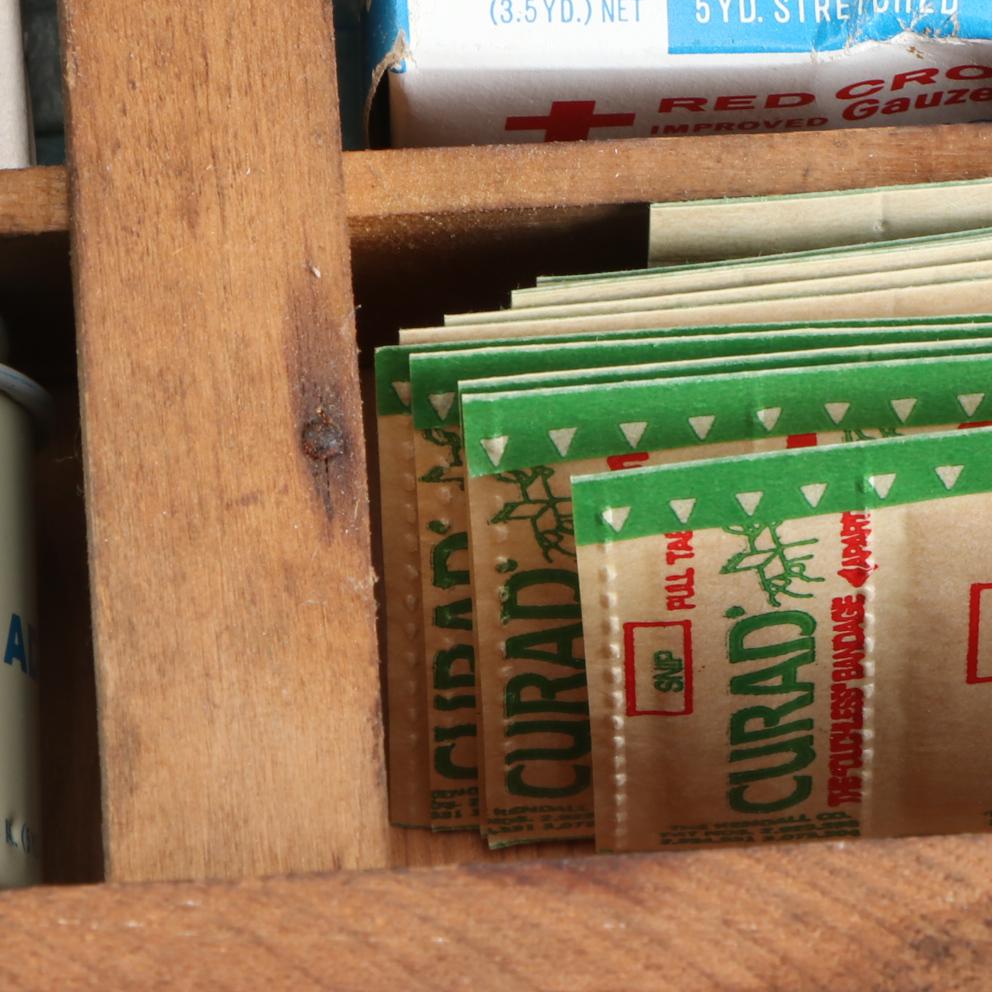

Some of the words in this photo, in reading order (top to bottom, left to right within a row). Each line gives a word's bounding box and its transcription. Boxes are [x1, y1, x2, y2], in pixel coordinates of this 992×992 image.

[651, 116, 829, 135] IMPROVED
[657, 92, 815, 114] RED
[664, 567, 696, 612] PULL
[831, 594, 866, 682] BANDAGE
[505, 569, 594, 798] CURAD
[652, 649, 685, 694] SNIP
[729, 609, 817, 814] CURAD
